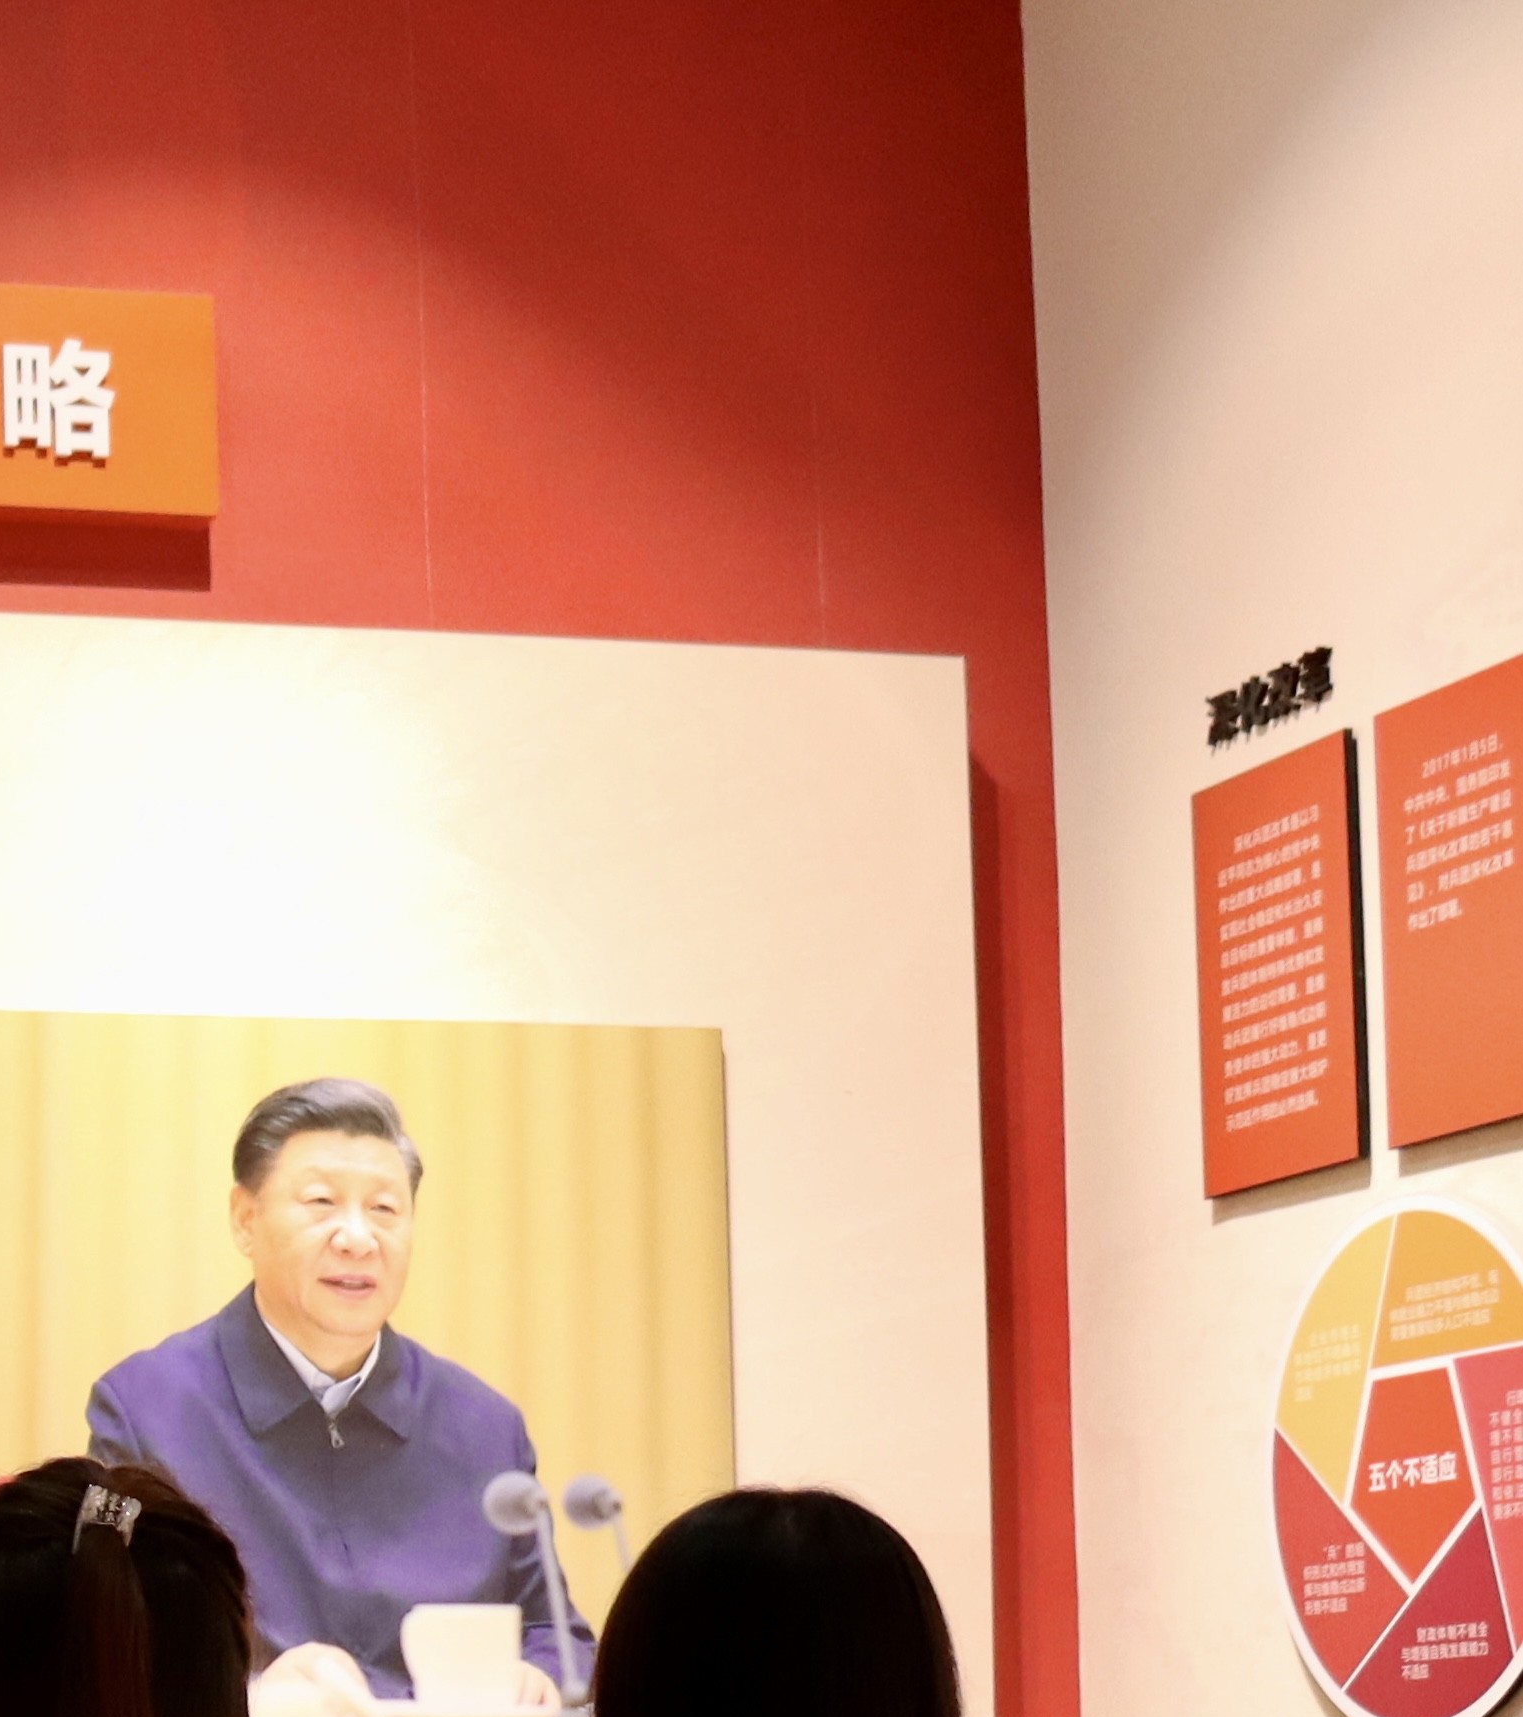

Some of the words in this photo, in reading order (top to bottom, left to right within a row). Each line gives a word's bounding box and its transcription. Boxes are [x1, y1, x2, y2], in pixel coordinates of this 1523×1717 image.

[1368, 1450, 1458, 1493] 五个不适应
